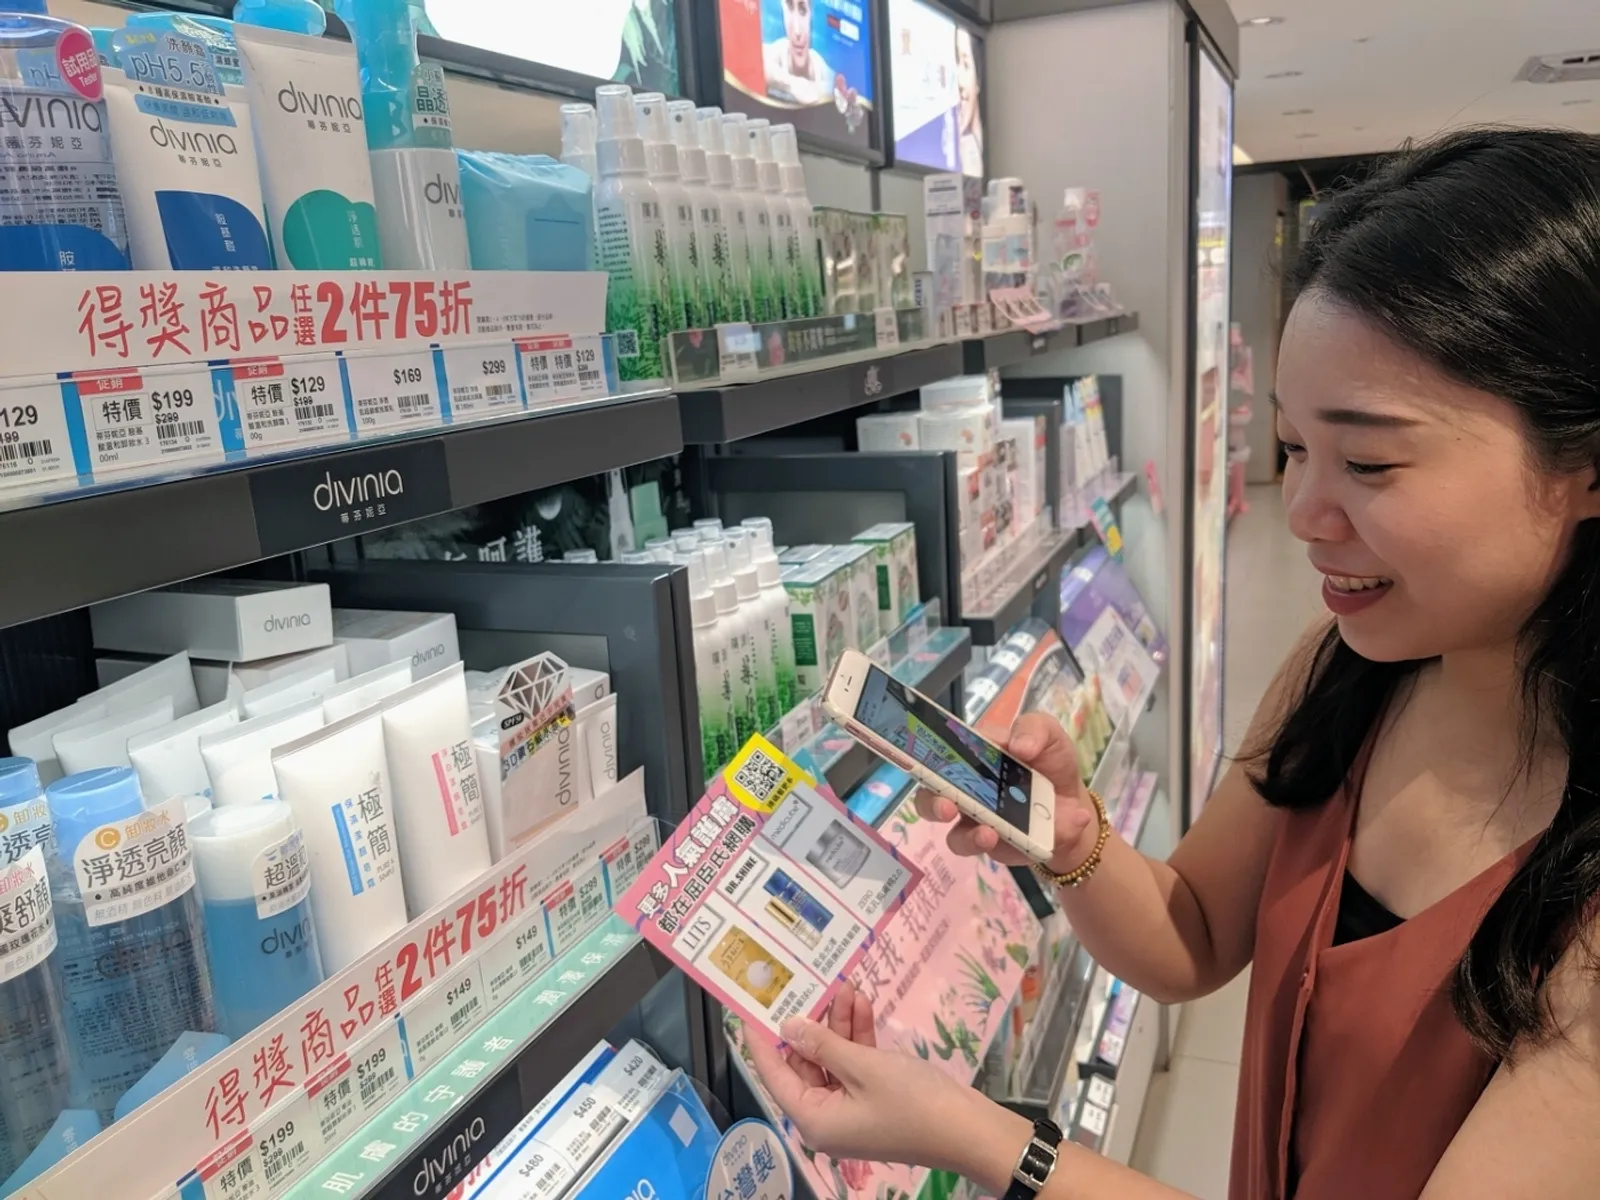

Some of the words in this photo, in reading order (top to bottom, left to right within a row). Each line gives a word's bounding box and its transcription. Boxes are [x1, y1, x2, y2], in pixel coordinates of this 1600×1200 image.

[130, 54, 205, 87] pH5.5
[278, 81, 363, 121] divinia
[150, 118, 238, 155] divinia
[393, 367, 422, 385] $169
[482, 360, 506, 375] $299
[151, 389, 193, 411] $199
[251, 384, 284, 405] 特價
[291, 376, 325, 395] $129
[102, 398, 143, 423] 特價
[313, 471, 404, 511] divinia
[264, 613, 311, 632] divinia
[412, 643, 445, 667] divinia
[555, 728, 573, 805] divinia
[357, 787, 392, 860] 極簡
[638, 794, 740, 919] 更多人氣護膚
[657, 812, 757, 935] 都在屈臣氏網購
[724, 856, 758, 895] DR.SHINE
[516, 926, 538, 950] $149
[682, 916, 712, 950] LITS
[446, 978, 471, 1006] $149
[357, 1048, 387, 1079] $199
[323, 1078, 352, 1110] 特價
[573, 1096, 597, 1119] $450
[321, 1036, 516, 1195] 肌膚的守護者
[260, 1121, 295, 1156] $199
[413, 1116, 486, 1196] divinia
[518, 1153, 544, 1178] $480
[220, 1155, 253, 1192] 特價
